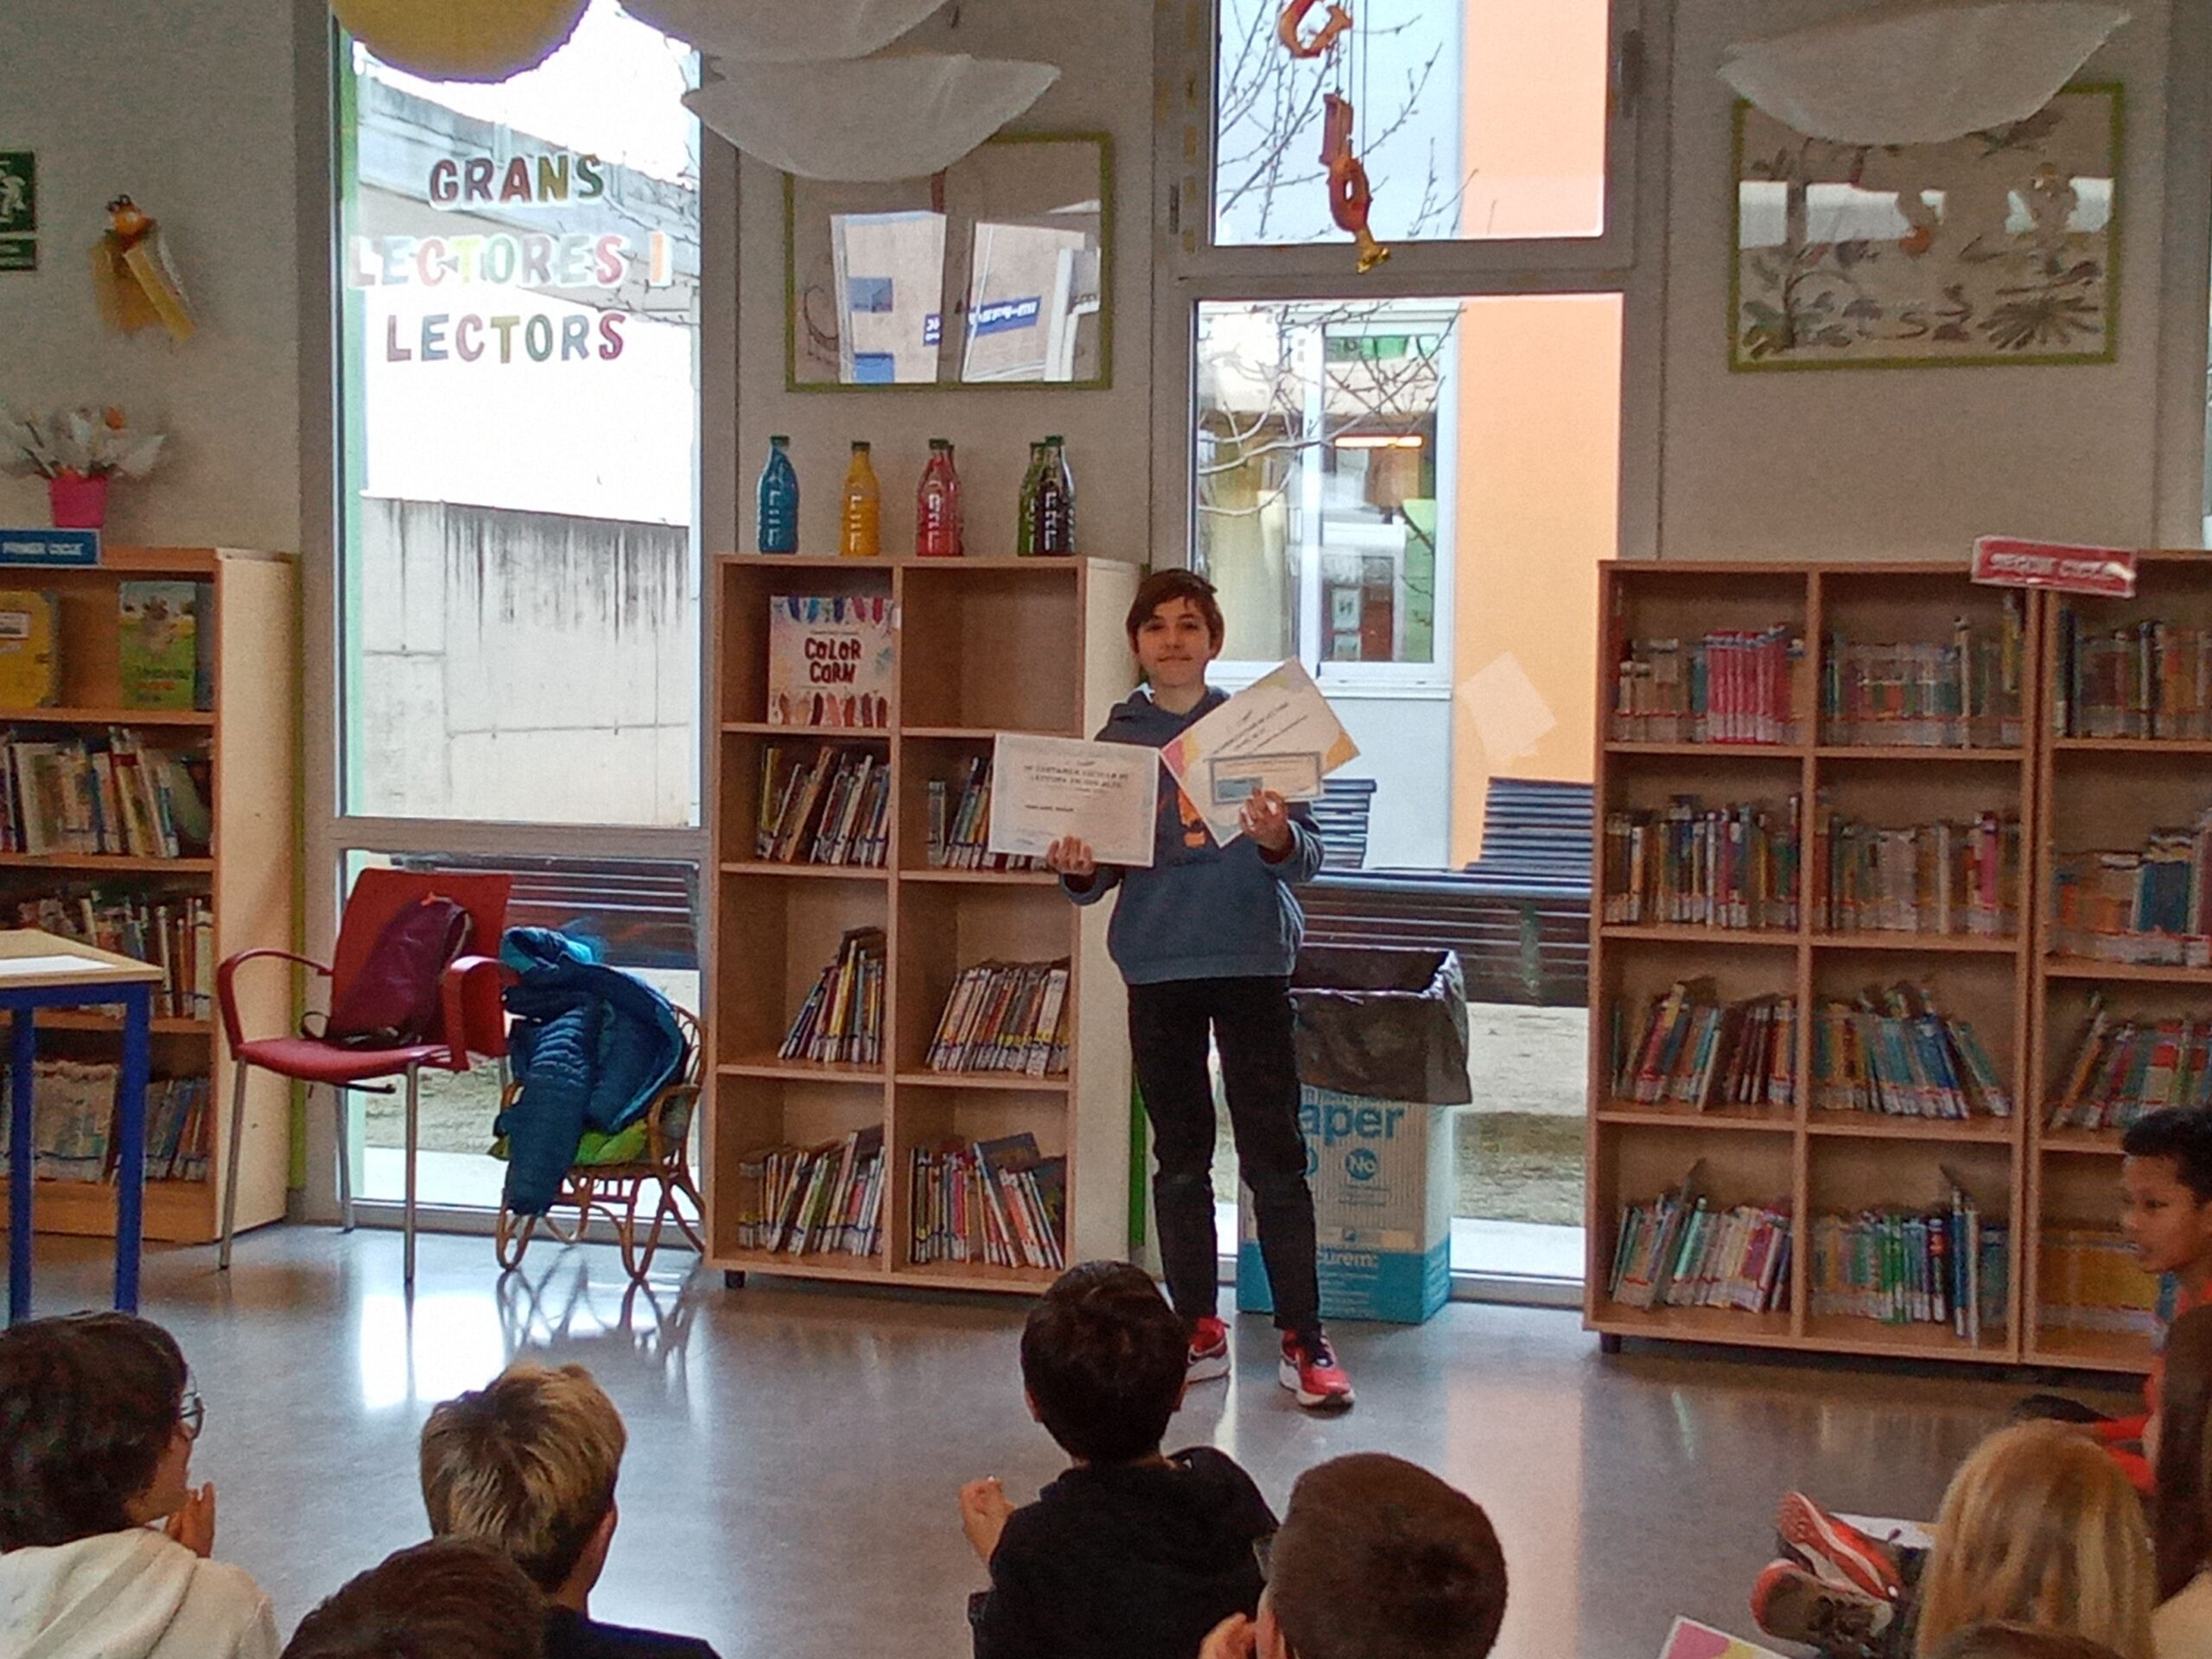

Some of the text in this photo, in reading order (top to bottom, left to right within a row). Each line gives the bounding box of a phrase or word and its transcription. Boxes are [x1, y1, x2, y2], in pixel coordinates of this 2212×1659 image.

[431, 153, 605, 204] GRANS
[350, 234, 625, 287] LECTORES
[386, 312, 626, 364] LECTORS
[804, 637, 861, 660] COLOR
[1299, 1103, 1405, 1146] aper
